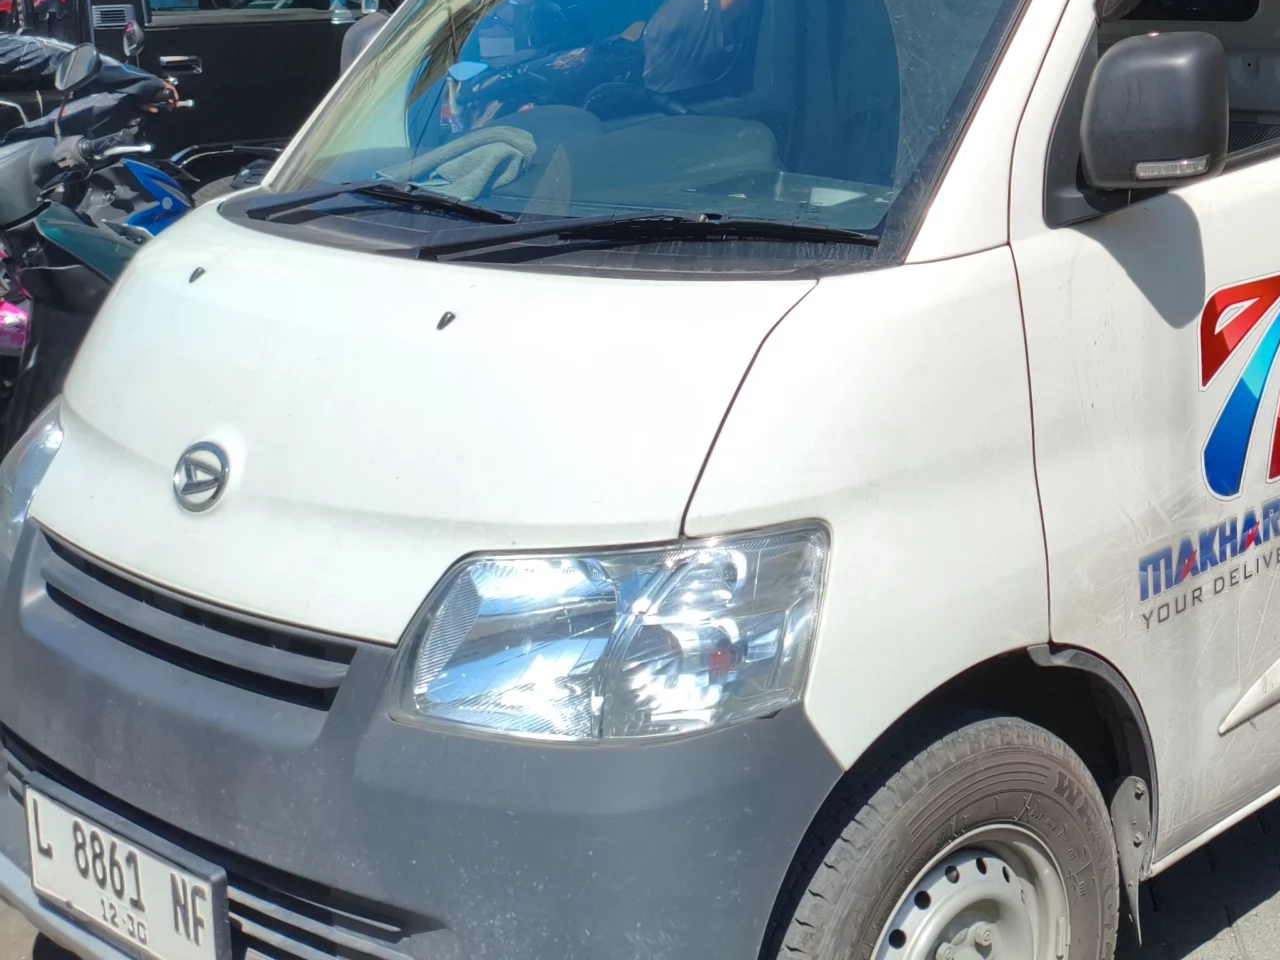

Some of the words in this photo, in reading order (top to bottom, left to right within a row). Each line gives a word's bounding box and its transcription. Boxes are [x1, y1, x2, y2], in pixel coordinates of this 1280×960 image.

[1140, 584, 1204, 631] YOUR
[33, 797, 54, 859] L
[72, 820, 146, 913] 8861
[169, 871, 208, 948] NF
